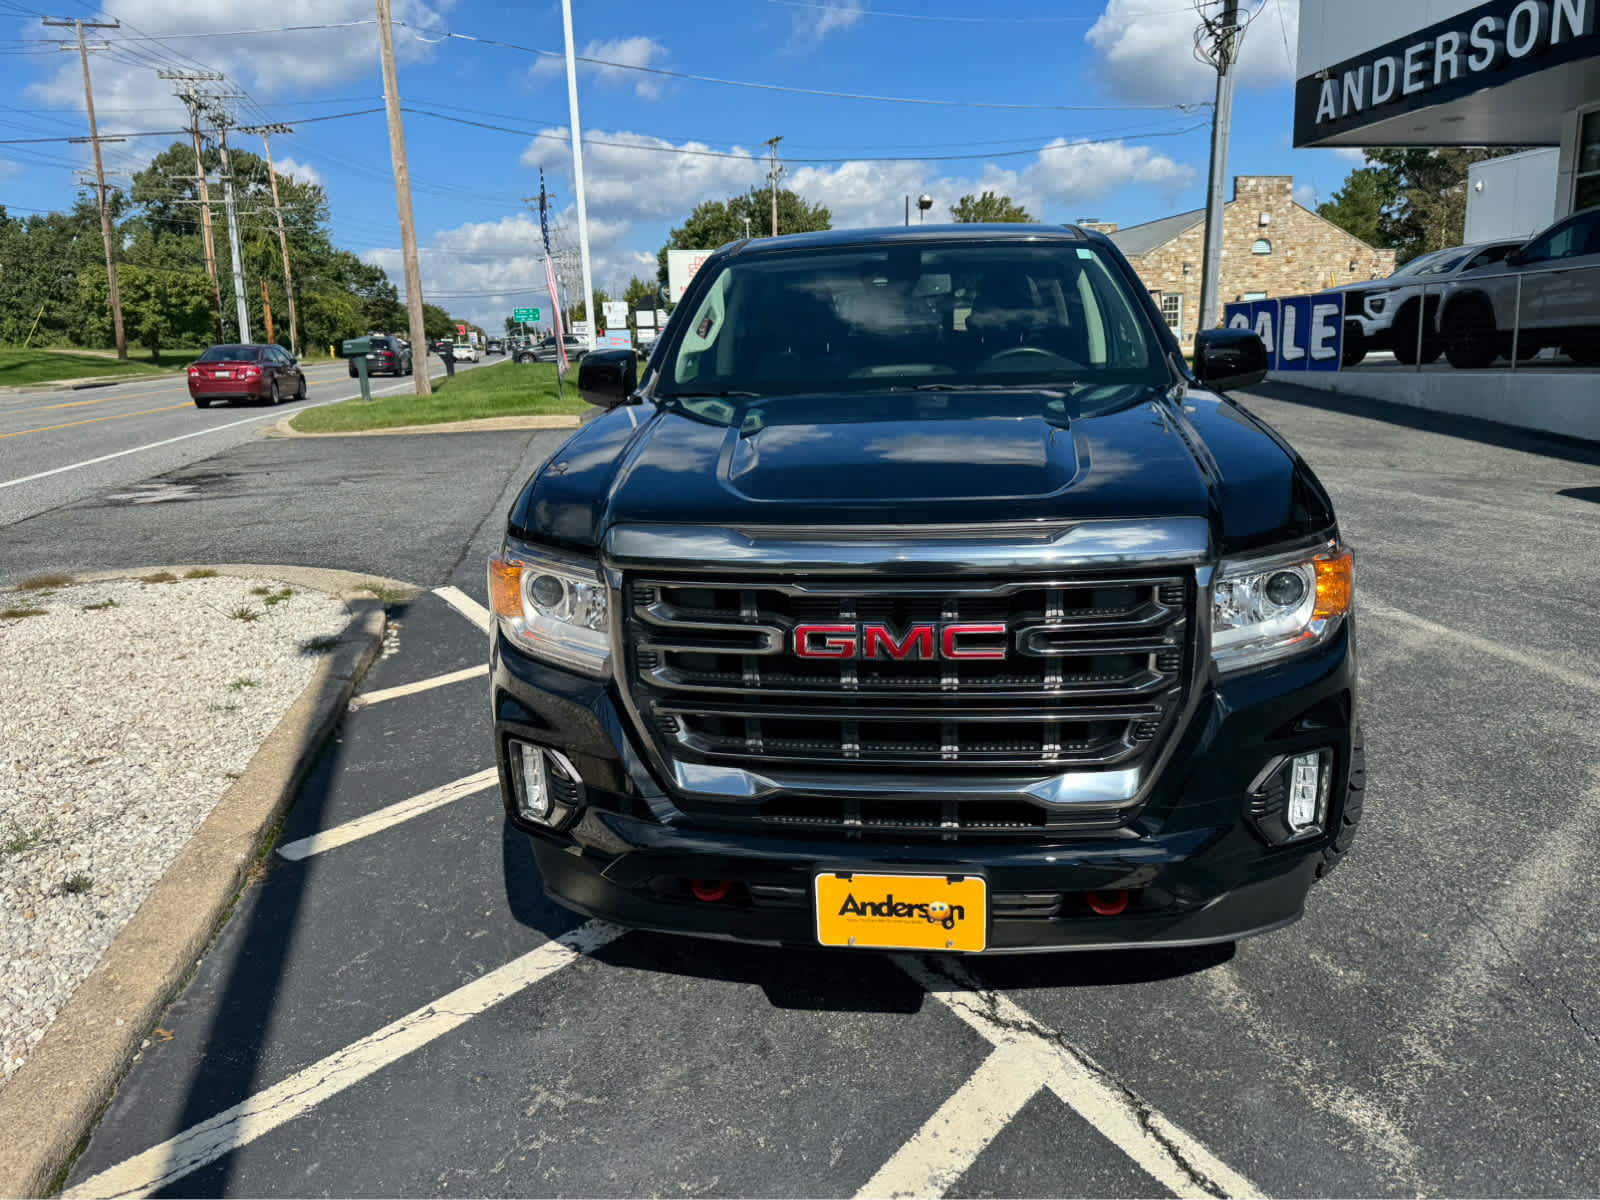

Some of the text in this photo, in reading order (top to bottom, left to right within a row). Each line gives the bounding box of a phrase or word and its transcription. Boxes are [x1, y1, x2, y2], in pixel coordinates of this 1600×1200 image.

[1315, 0, 1586, 124] ANDERSON
[794, 622, 1006, 660] GMC
[838, 892, 965, 923] Anderson
